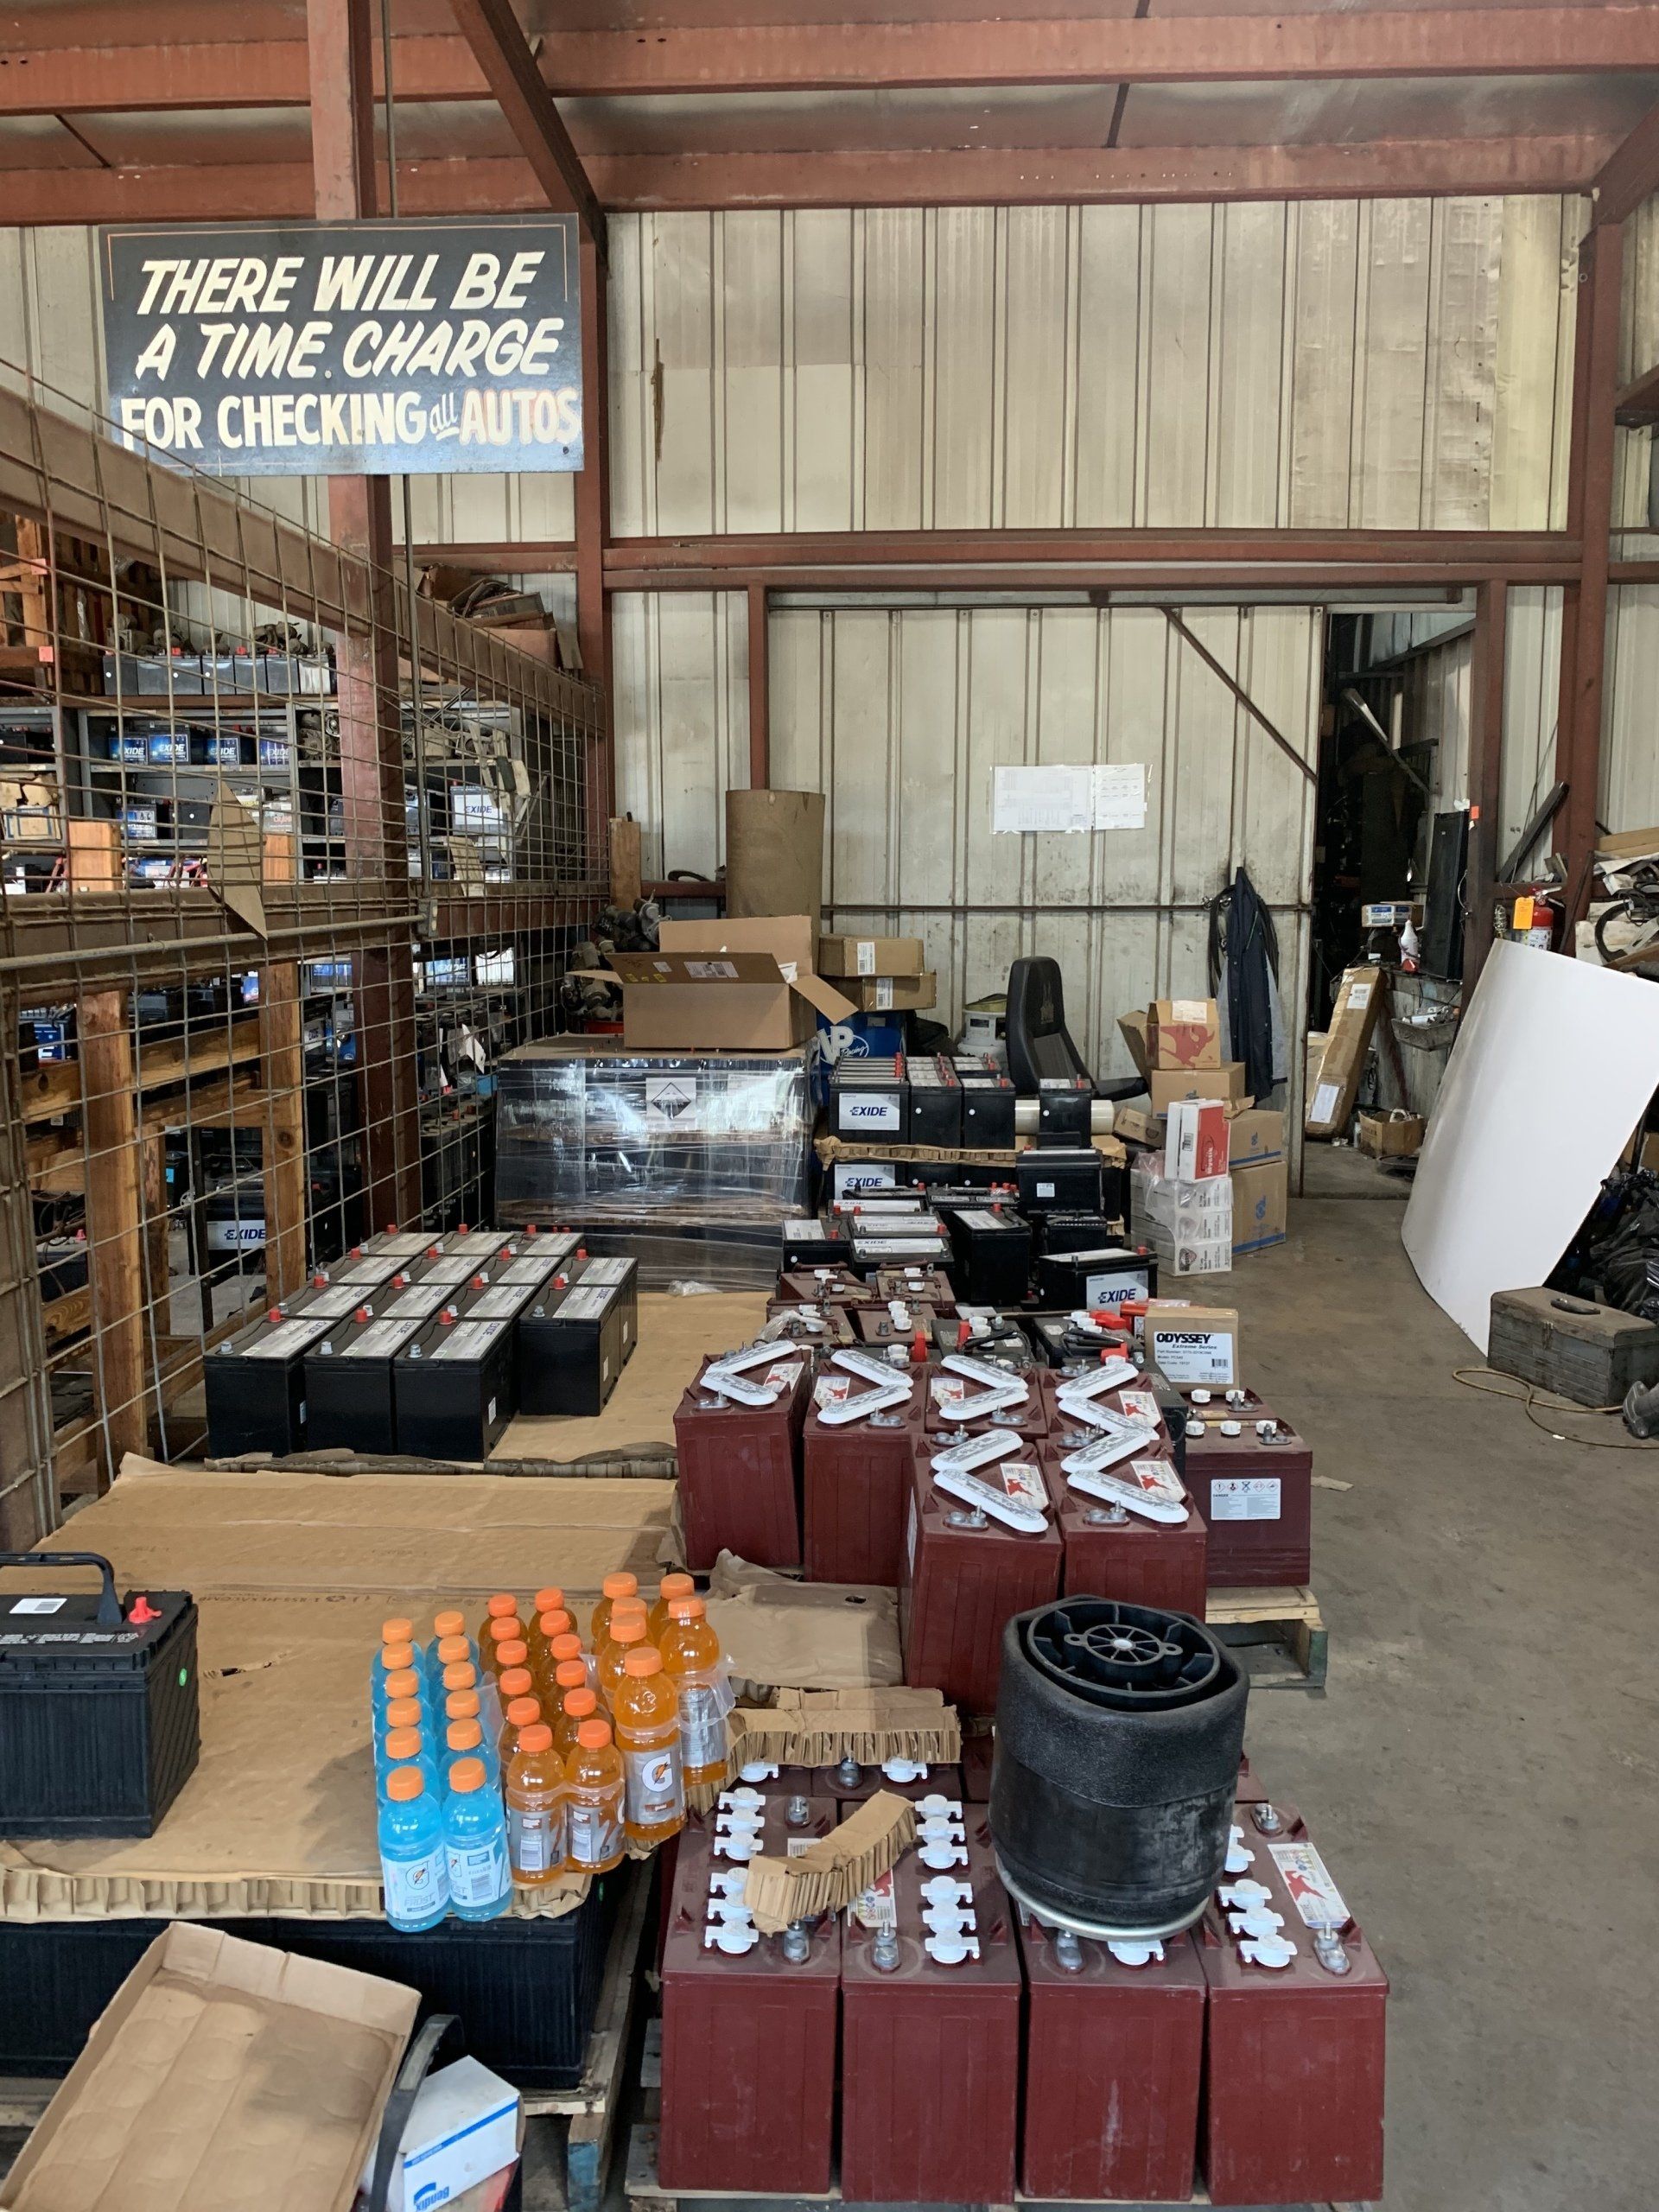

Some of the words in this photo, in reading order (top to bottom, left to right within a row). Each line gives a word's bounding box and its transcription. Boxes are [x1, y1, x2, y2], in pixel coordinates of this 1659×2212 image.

[137, 257, 304, 315] THERE
[314, 253, 440, 312] WILL
[449, 250, 545, 311] BE
[135, 324, 178, 381] A
[196, 321, 333, 380] TIME
[343, 317, 565, 378] CHARGE
[121, 397, 204, 451] FOR
[216, 391, 429, 448] CHECKING
[429, 391, 459, 435] all
[459, 387, 581, 447] AUTOS
[210, 747, 236, 756] EIDE
[465, 805, 493, 814] EXIDE
[817, 1026, 855, 1065] VP
[841, 1044, 868, 1058] Racing
[849, 1106, 887, 1116] EXIDE
[845, 1178, 883, 1187] EXIDE
[224, 1229, 266, 1241] EXIDE
[1097, 1287, 1137, 1304] EXIDE
[1156, 1332, 1211, 1344] ODYSSEY
[642, 1752, 673, 1792] G
[404, 1893, 435, 1907] FROST
[415, 2186, 449, 2212] Bendix
